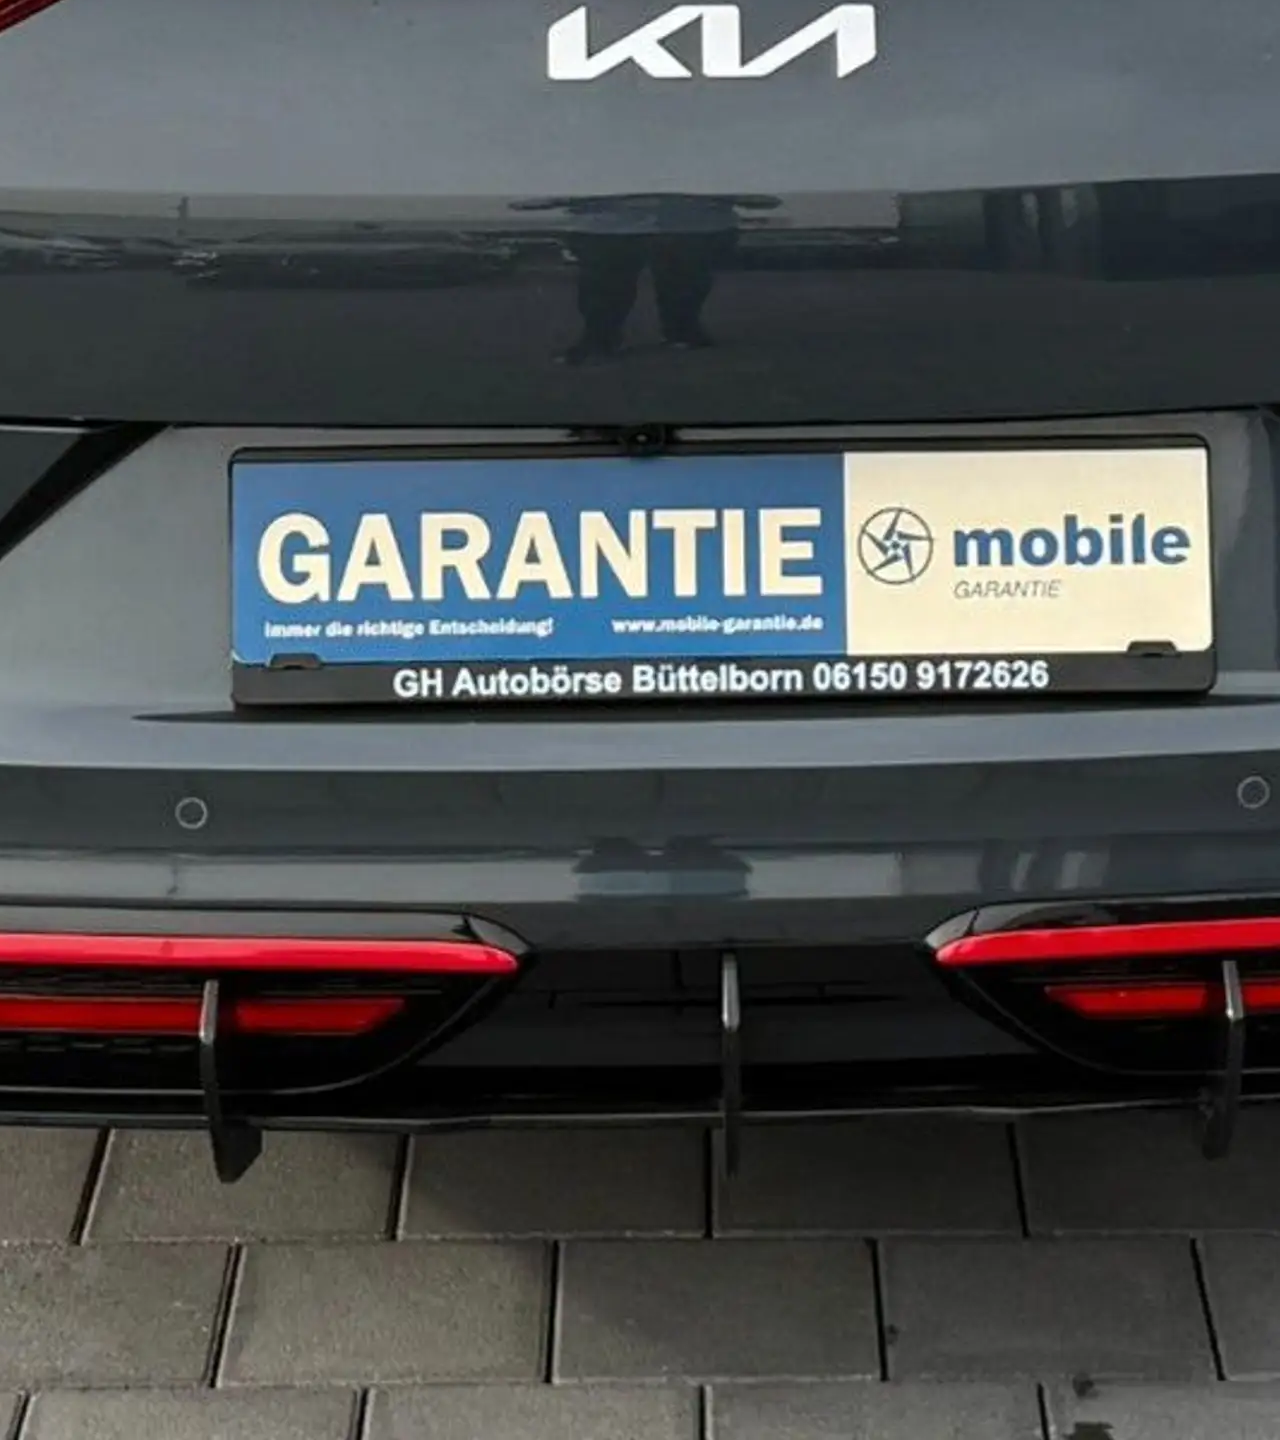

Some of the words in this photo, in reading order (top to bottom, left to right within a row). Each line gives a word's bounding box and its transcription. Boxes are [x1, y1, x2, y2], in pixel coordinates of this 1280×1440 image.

[547, 4, 877, 80] KIA
[258, 508, 823, 604] GARANTIE
[953, 513, 1191, 566] mobile
[953, 578, 1062, 600] GARANTIE
[264, 621, 320, 638] Immer
[324, 620, 354, 637] die
[357, 618, 425, 639] richtige
[428, 616, 555, 638] Entscheidung!
[611, 614, 825, 635] www.mobile-garantie.de
[392, 667, 444, 698] GH
[451, 665, 623, 697] Autobörse
[632, 663, 804, 694] Büttelborn
[813, 661, 909, 691] 06150
[915, 659, 1050, 690] 9172626
